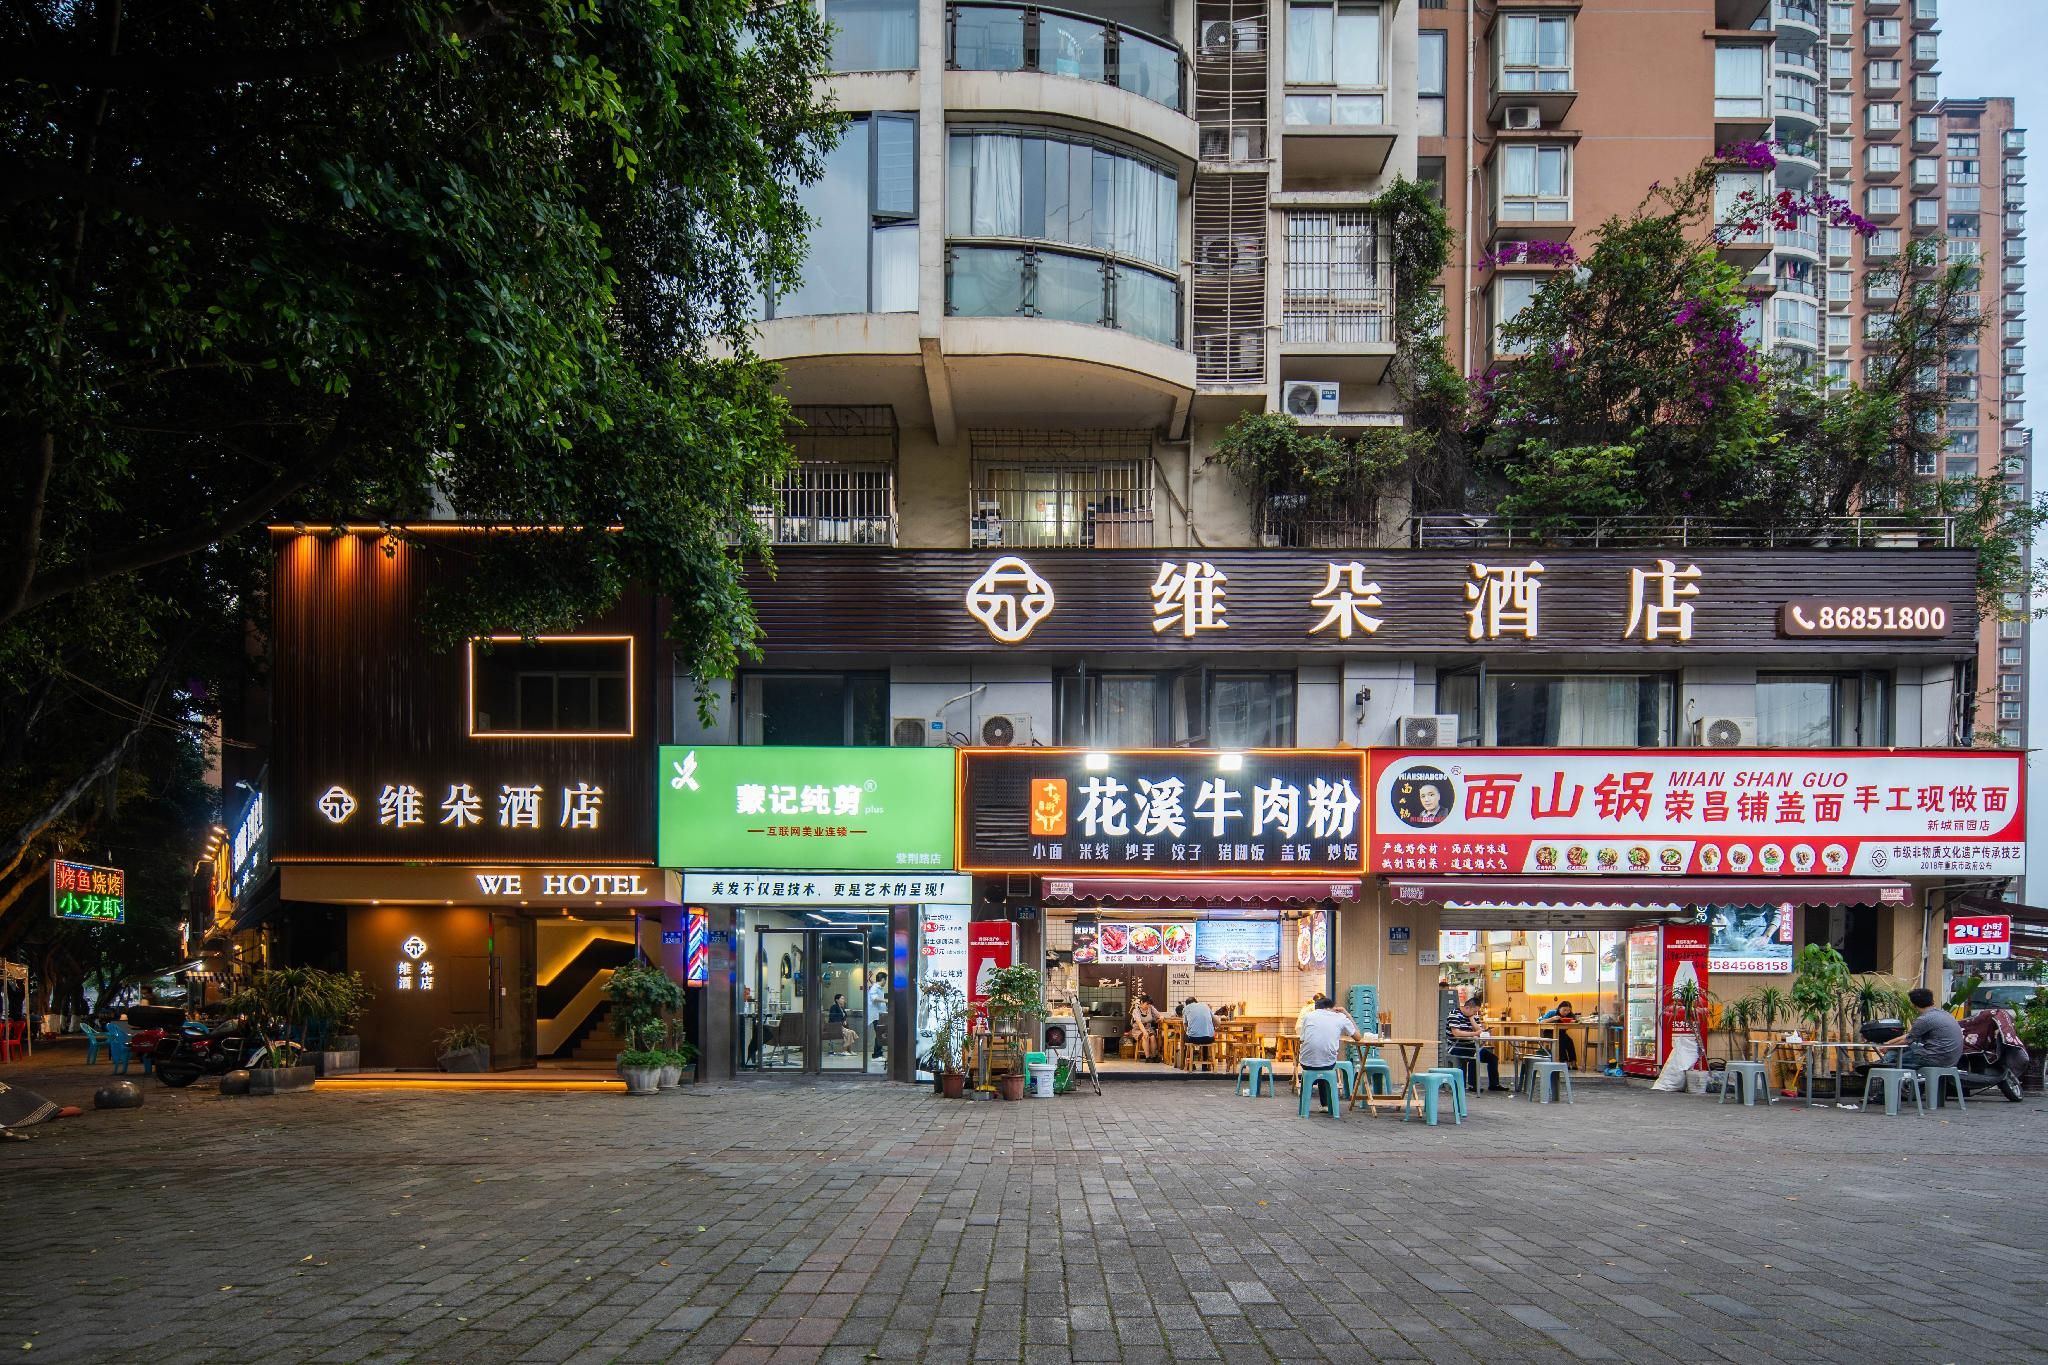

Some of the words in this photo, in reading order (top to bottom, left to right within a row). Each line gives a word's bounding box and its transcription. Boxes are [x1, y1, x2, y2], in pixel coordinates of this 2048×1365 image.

[1151, 560, 1702, 640] 维朵酒店
[1819, 606, 1946, 630] 86851800
[1668, 771, 1725, 787] MIAN
[1733, 771, 1793, 788] SHAN
[1802, 772, 1849, 789] GUO
[378, 783, 605, 829] 维朵酒店
[735, 783, 863, 816] 蒙记纯剪
[1463, 771, 1654, 823] 面山锅
[1853, 785, 2010, 814] 手工现做面
[864, 805, 884, 815] plus
[1077, 776, 1361, 838] 花溪牛肉粉
[1664, 790, 1846, 824] 荣昌铺盖面
[766, 826, 848, 837] 互联网美业连锁
[1927, 820, 1990, 832] 新城丽园店
[1032, 843, 1062, 861] 小面
[1079, 843, 1110, 861] 米线
[1171, 843, 1202, 861] 饺子
[1218, 843, 1265, 861] 猪脚饭
[1281, 843, 1311, 861] 盖饭
[1327, 843, 1358, 861] 炒饭
[1892, 846, 2021, 859] 市级非物质文化遗产传承技艺
[60, 866, 121, 896] 烤鱼烧烤
[476, 874, 523, 895] WE
[543, 874, 648, 895] HOTEL
[60, 891, 121, 919] 小龙虾
[1954, 924, 1979, 938] 24
[1982, 923, 2003, 931] 小时
[1982, 931, 2003, 939] 营业
[398, 961, 434, 975] 维朵
[398, 976, 434, 990] 酒店
